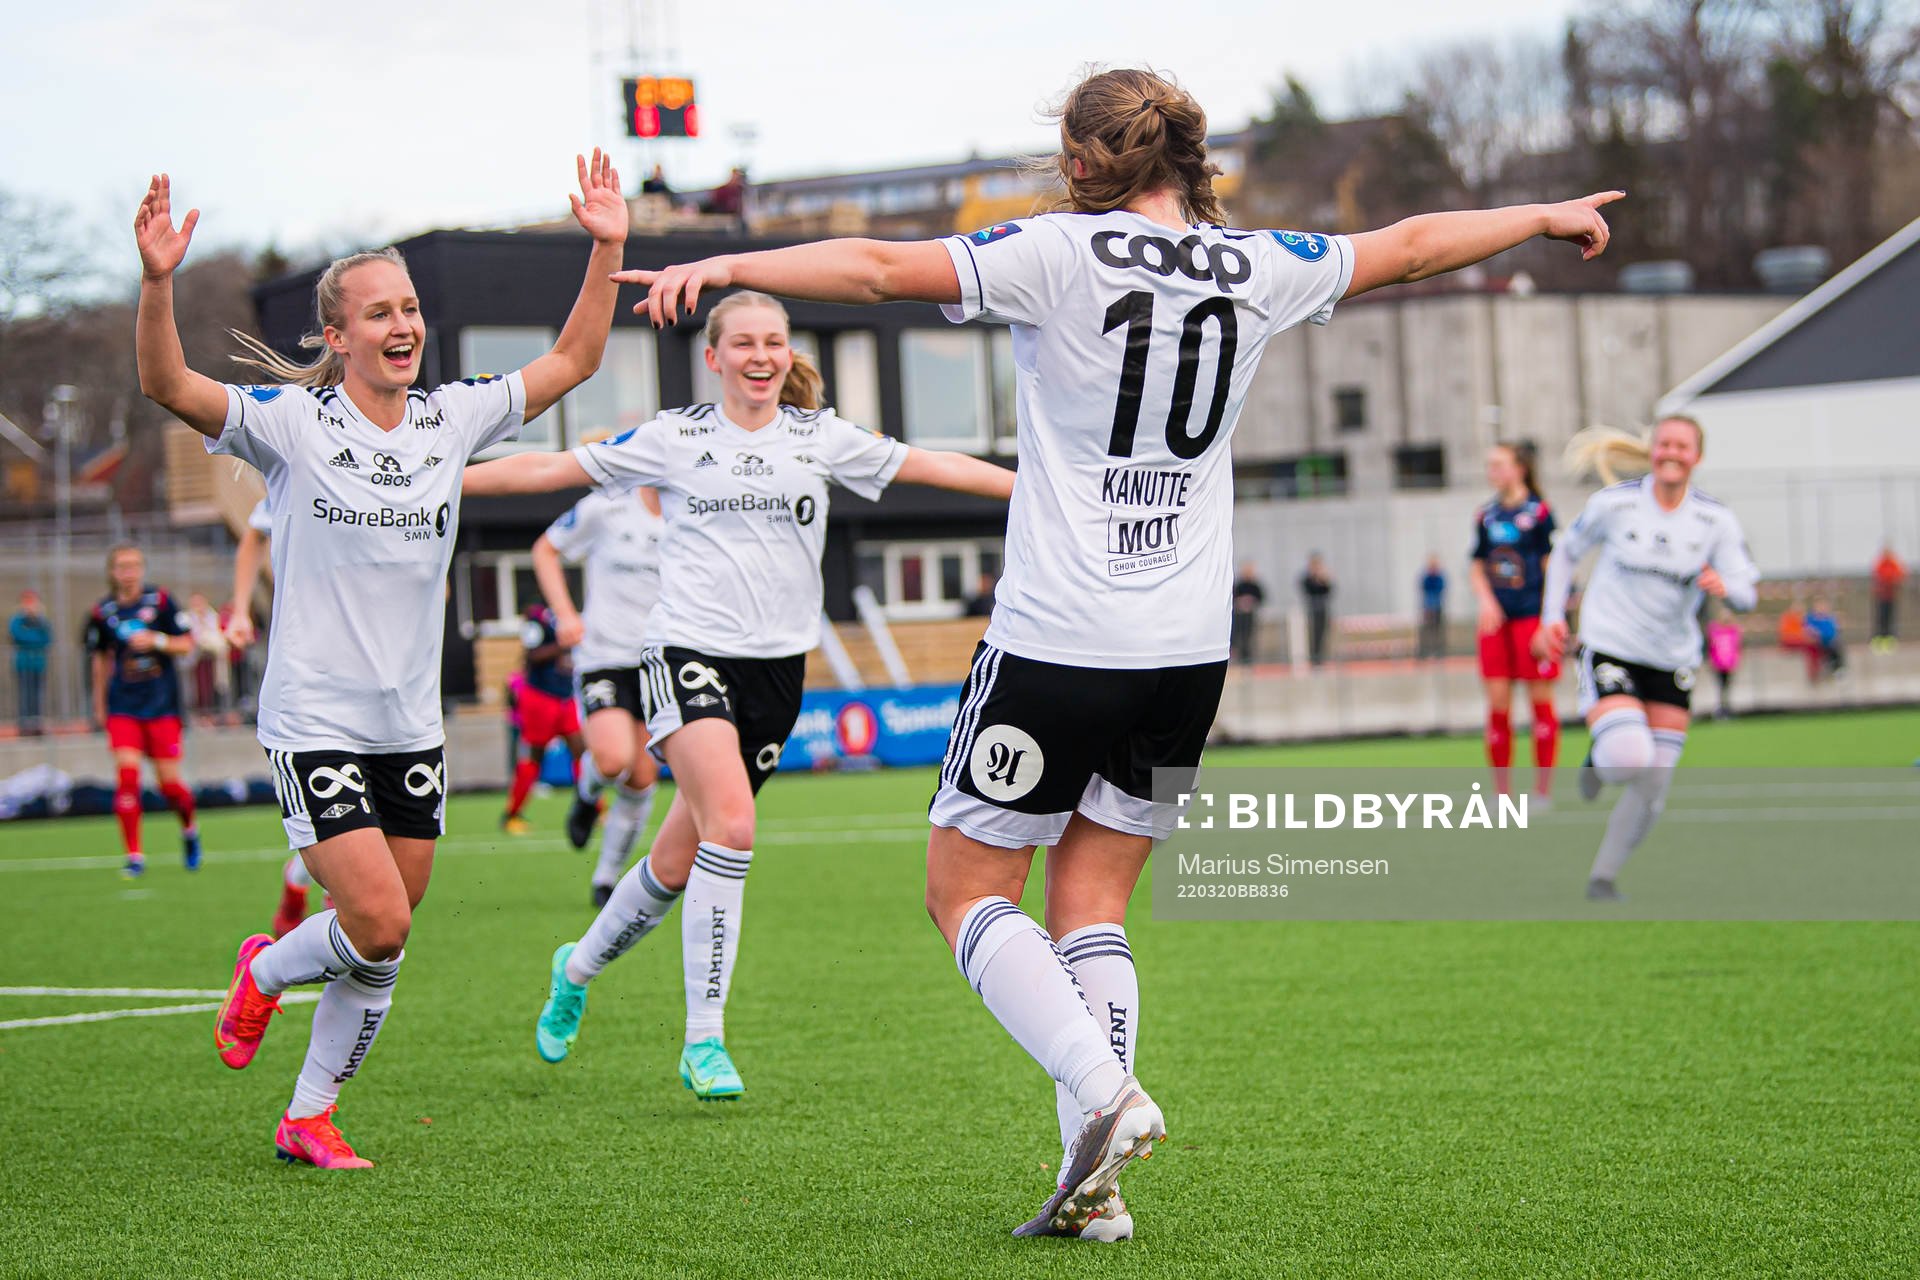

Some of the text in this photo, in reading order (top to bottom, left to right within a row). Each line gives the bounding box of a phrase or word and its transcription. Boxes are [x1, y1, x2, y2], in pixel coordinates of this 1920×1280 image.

[1091, 230, 1251, 293] coop
[1101, 290, 1239, 460] 10
[329, 460, 359, 470] adidas
[731, 465, 774, 476] OBOS
[371, 472, 412, 487] OBOS
[1103, 468, 1192, 507] KANUTTE
[313, 498, 431, 527] SpareBank
[686, 493, 791, 516] SpareBank
[766, 514, 791, 524] SMN
[404, 530, 431, 541] SMN
[1118, 513, 1179, 554] MOT
[1114, 553, 1173, 572] SHOW COURAGE!
[706, 906, 725, 1000] RAMIRENT
